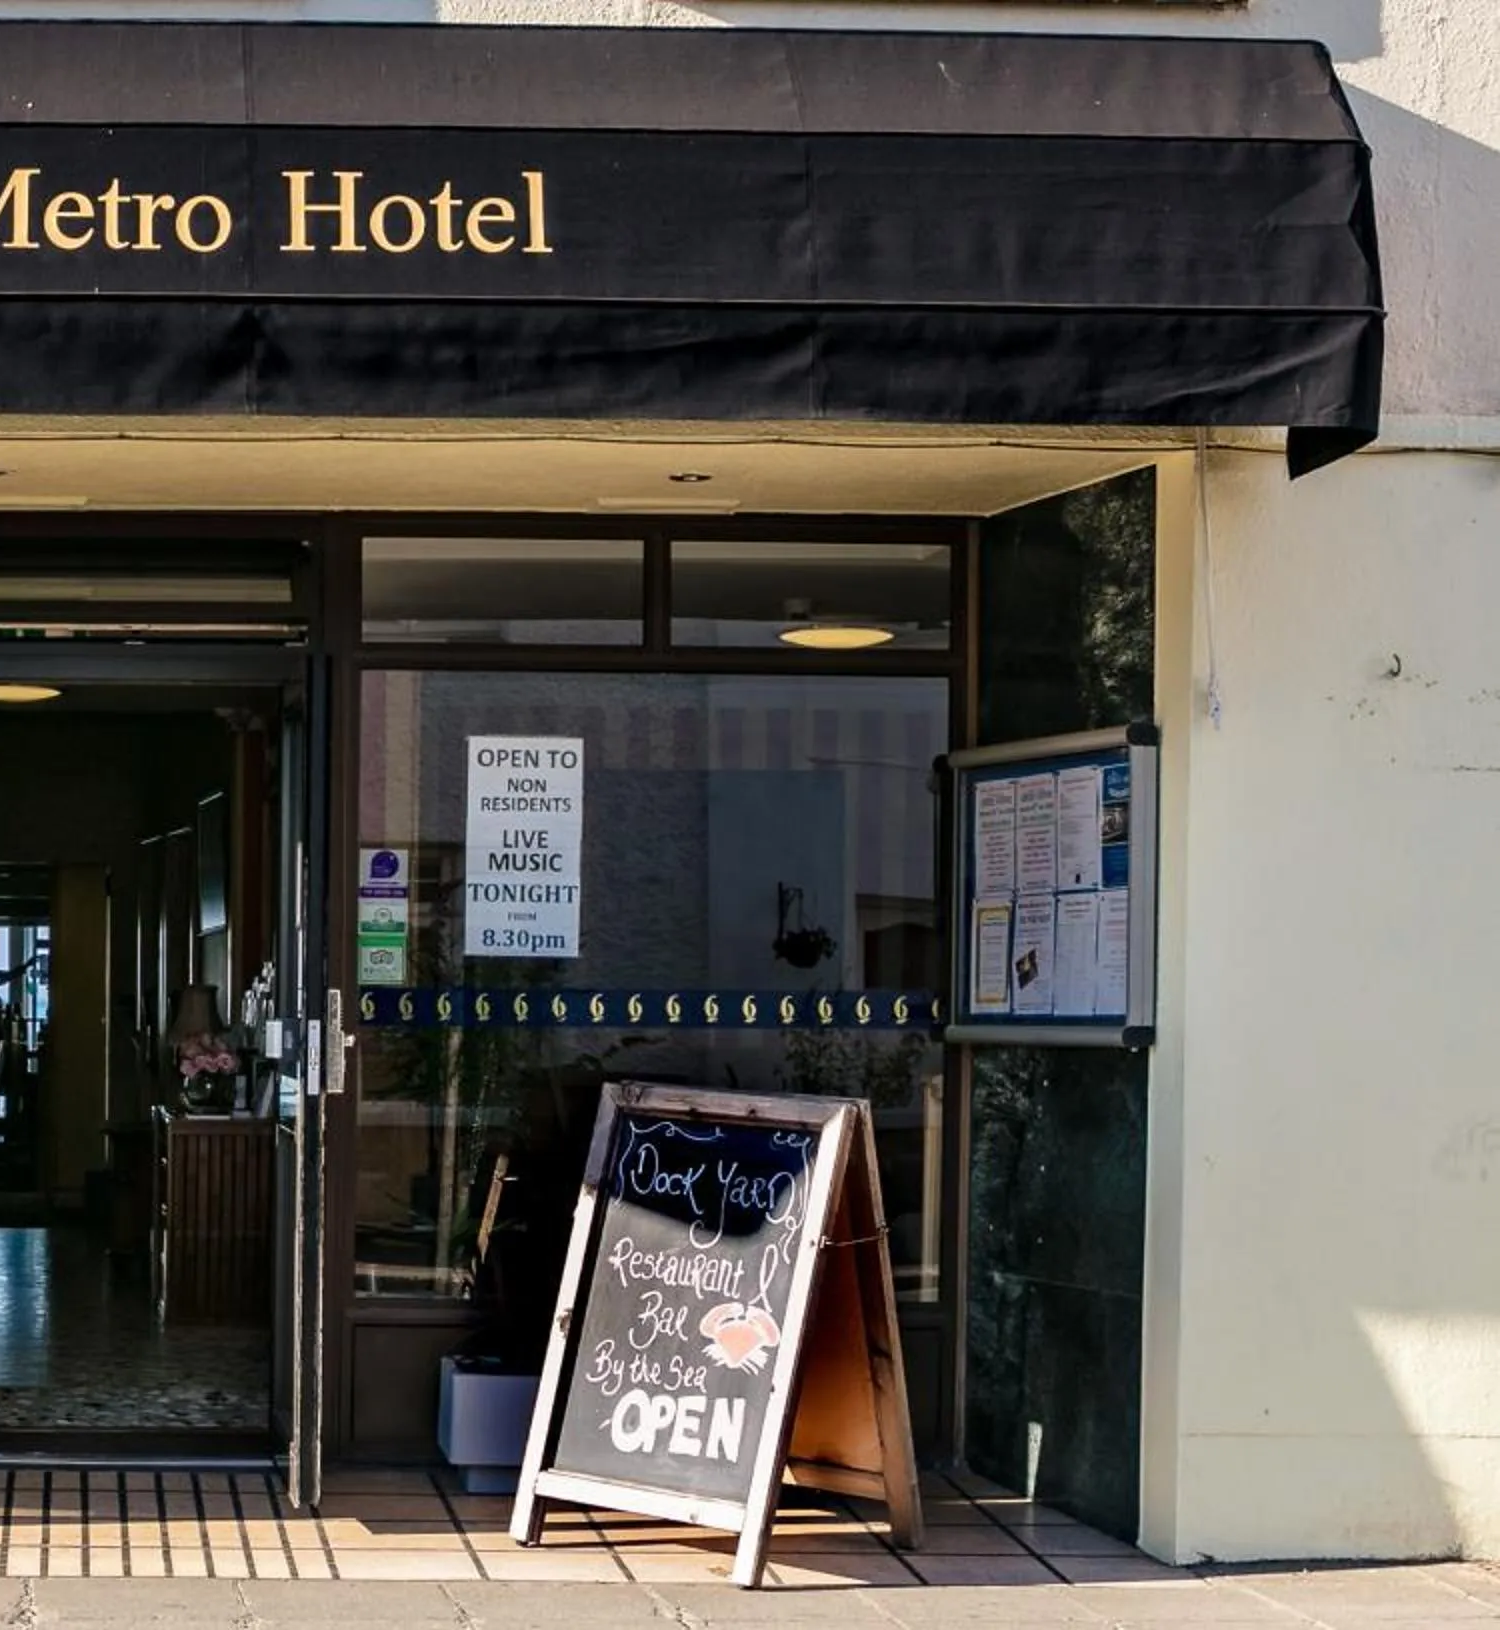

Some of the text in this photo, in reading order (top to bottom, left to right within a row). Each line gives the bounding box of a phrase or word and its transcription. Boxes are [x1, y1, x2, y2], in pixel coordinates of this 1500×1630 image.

[280, 170, 553, 254] Hotel
[477, 748, 578, 769] OPEN TO
[507, 778, 547, 793] NON
[480, 797, 572, 813] RESIDENTS
[502, 830, 549, 849] LIVE
[488, 853, 563, 873] MUSIC
[467, 883, 579, 904] TONIGHT
[481, 928, 566, 952] 8.30pm
[585, 1339, 708, 1396] By the Sea
[611, 1388, 746, 1464] OPEN
